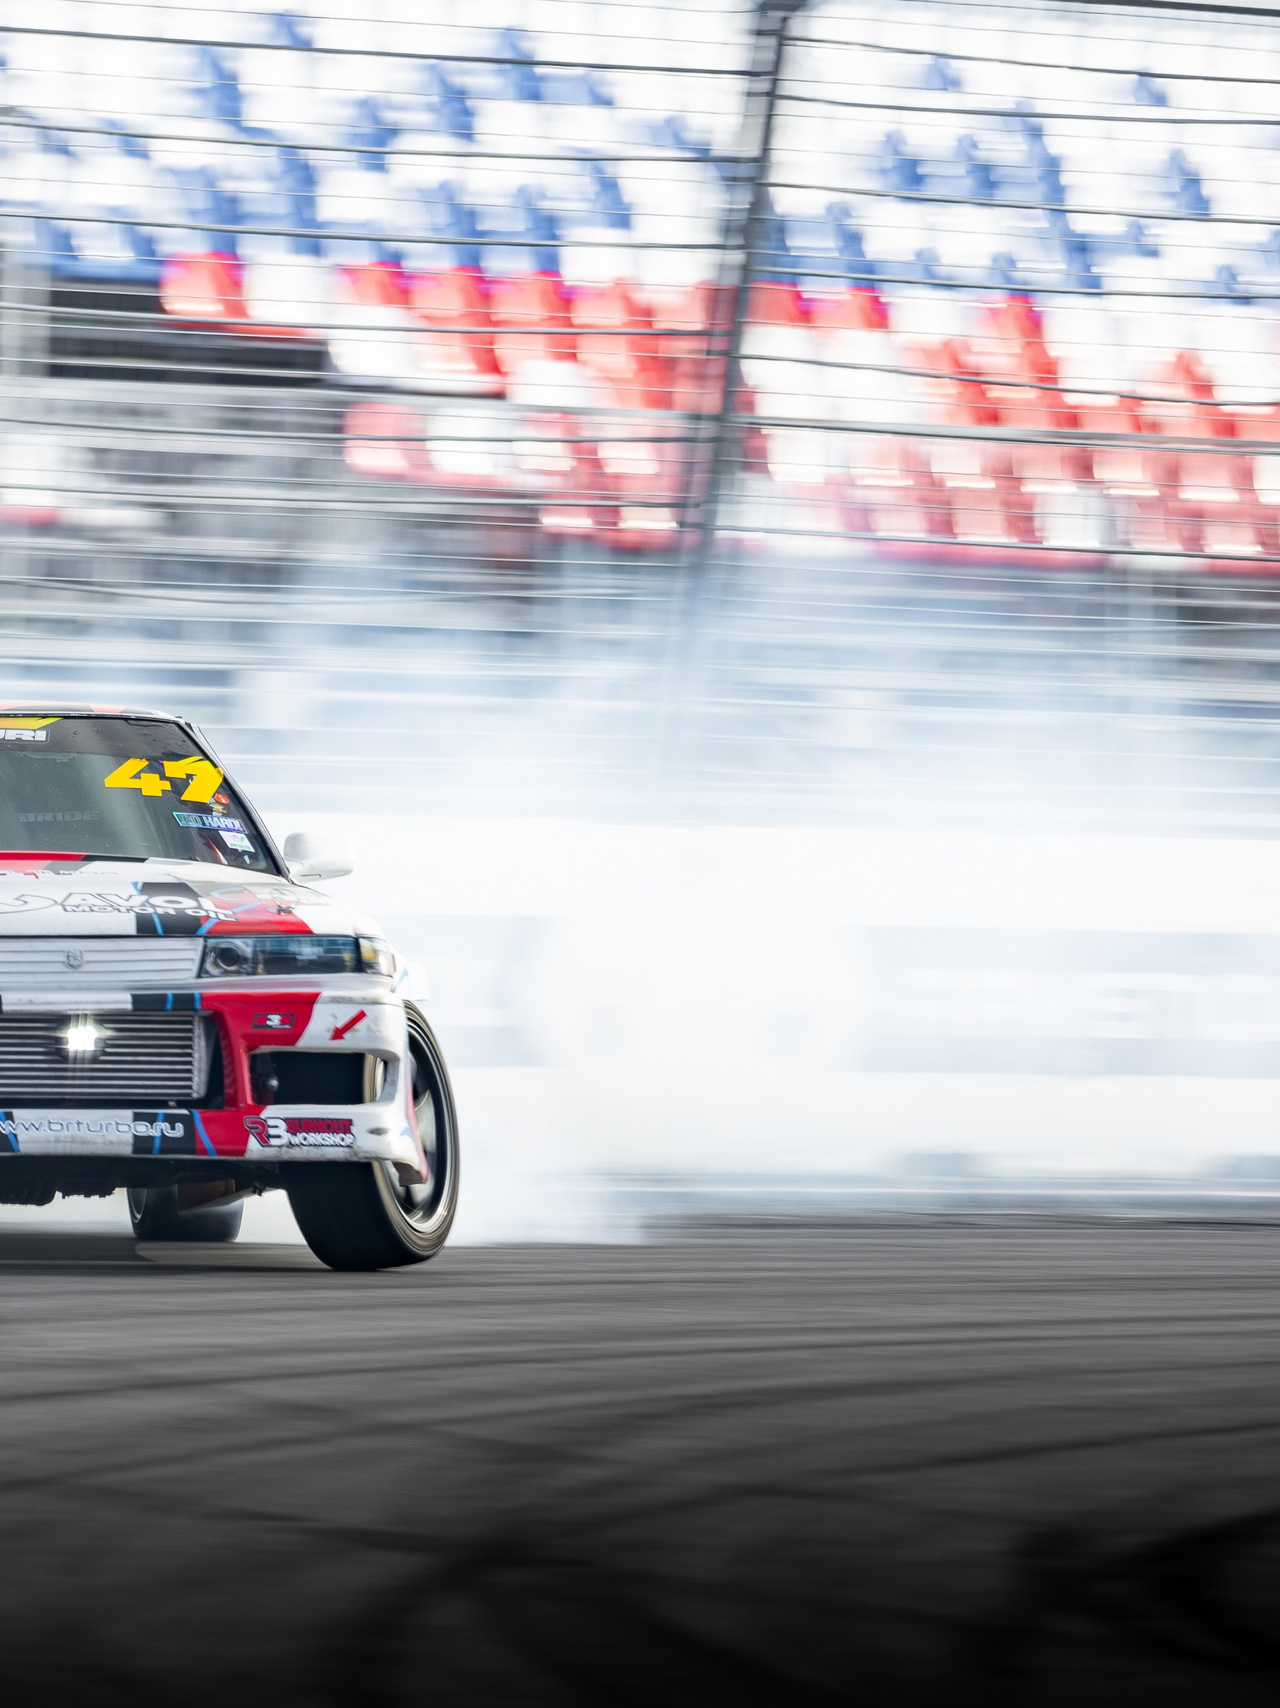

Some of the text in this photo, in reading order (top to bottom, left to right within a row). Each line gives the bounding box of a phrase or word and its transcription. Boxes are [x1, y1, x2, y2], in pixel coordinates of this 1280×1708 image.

[104, 757, 223, 803] 47
[17, 810, 100, 822] BRIDE
[63, 904, 239, 921] MOTOR OIL
[286, 1118, 353, 1134] BURNOUT
[287, 1131, 355, 1147] WORKSHOP
